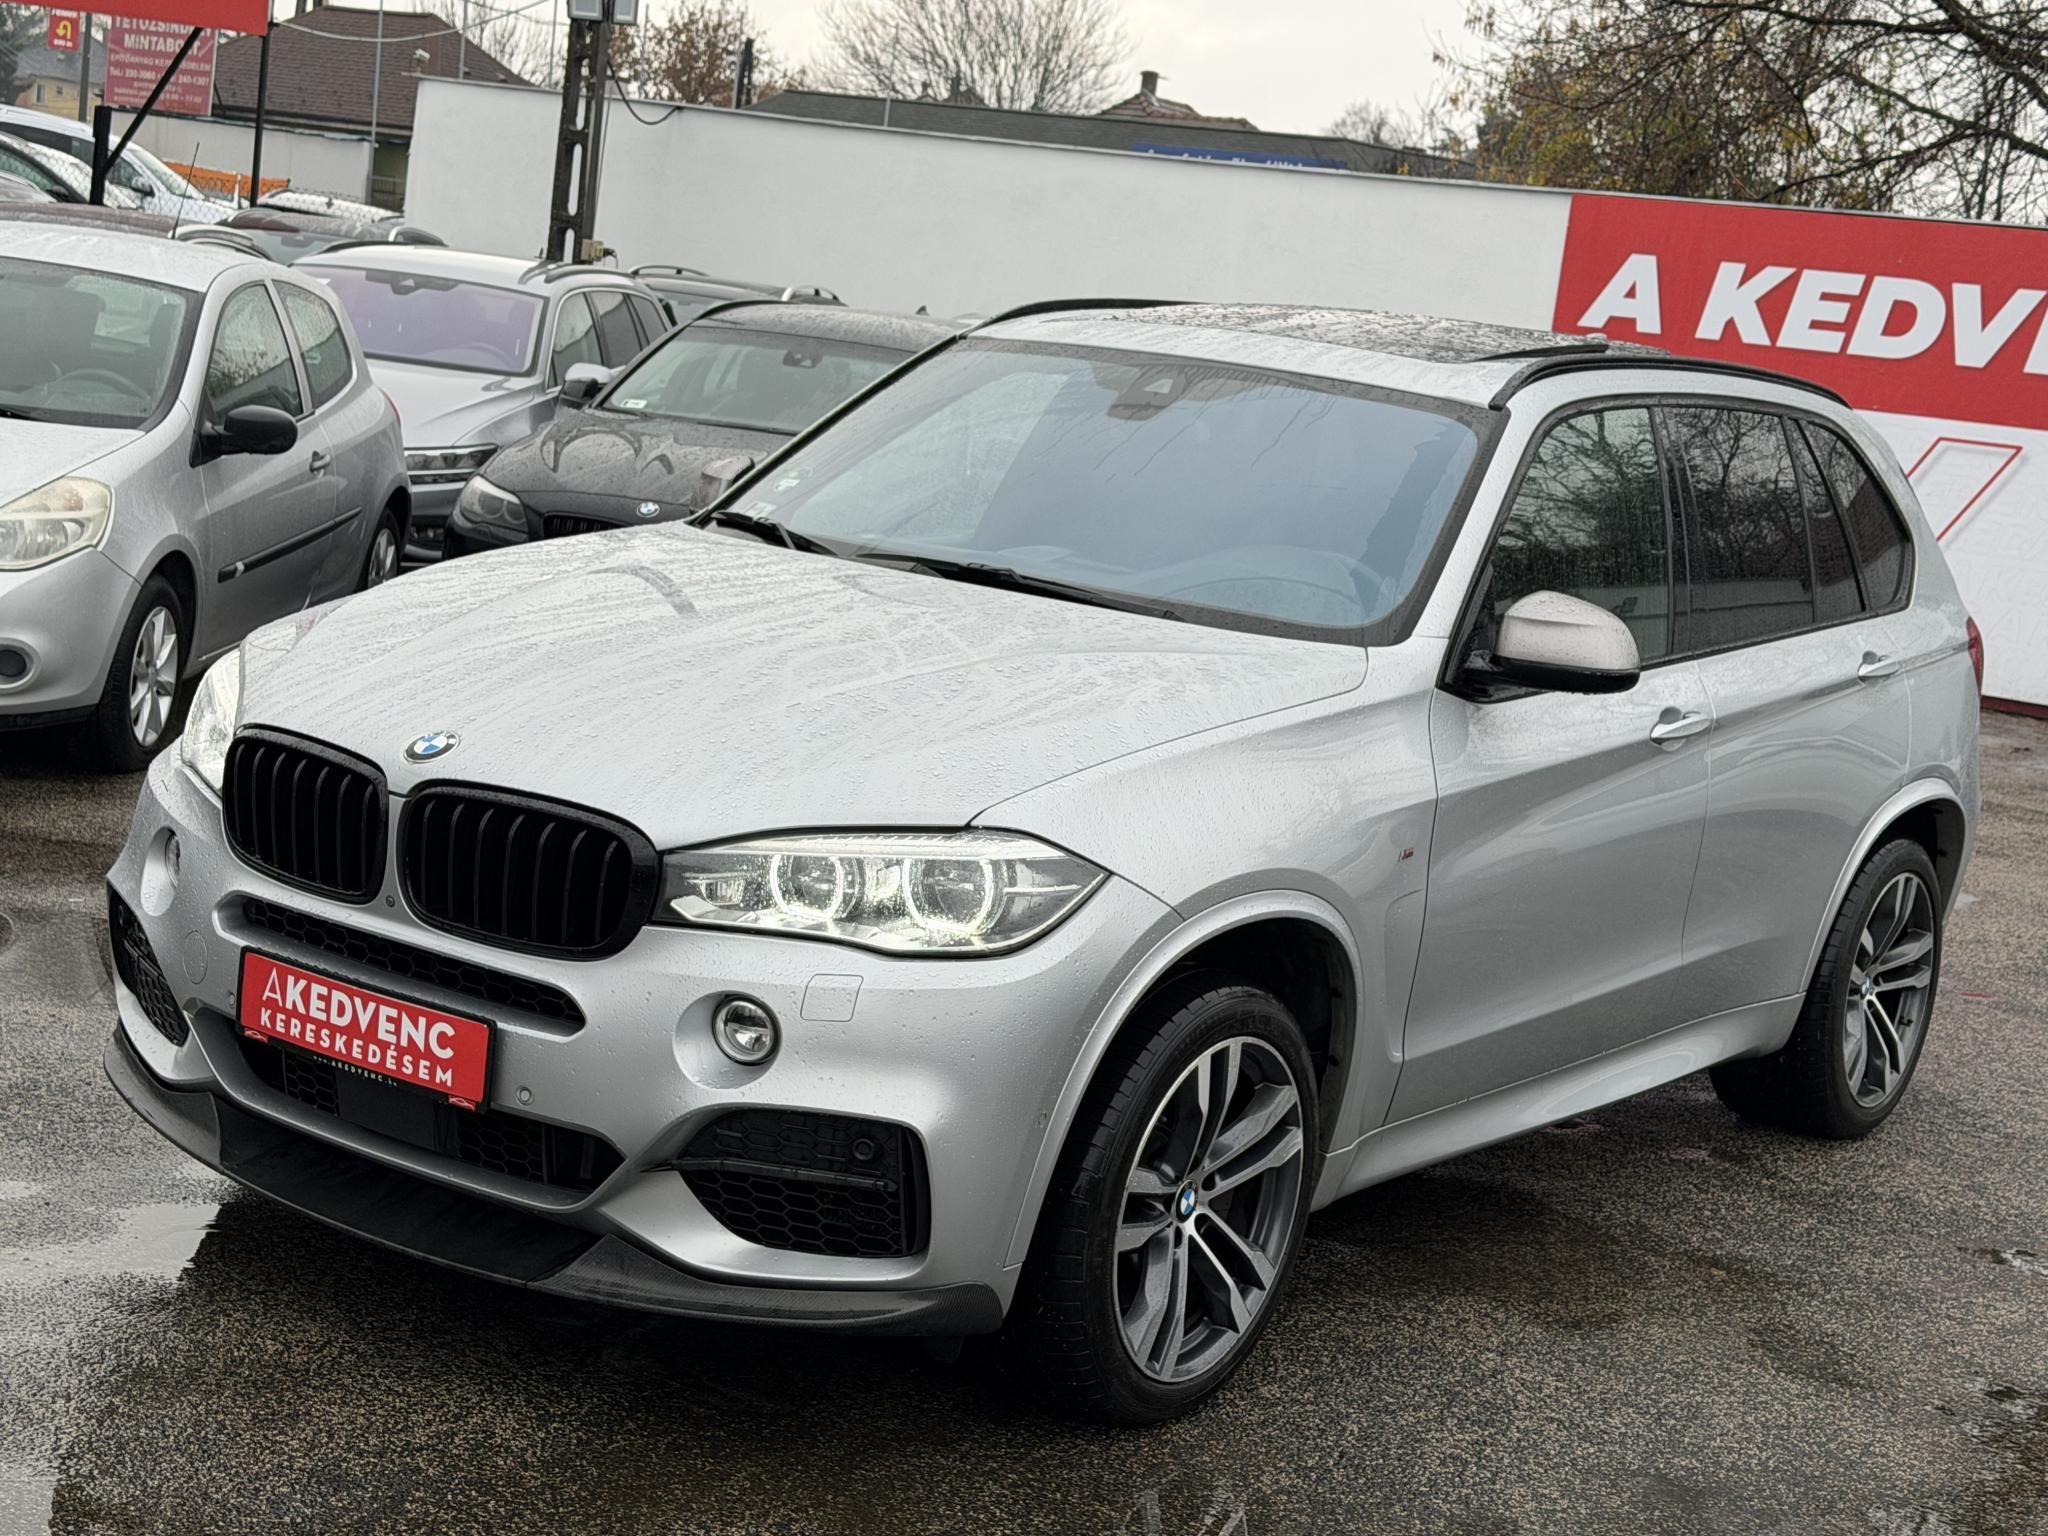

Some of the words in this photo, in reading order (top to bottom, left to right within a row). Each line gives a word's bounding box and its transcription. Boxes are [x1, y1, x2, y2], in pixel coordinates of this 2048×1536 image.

[124, 33, 201, 56] MINTABOT
[1577, 252, 1662, 335] A
[1694, 260, 2048, 376] KEDV
[260, 1007, 453, 1088] KERESKEDÉSEM
